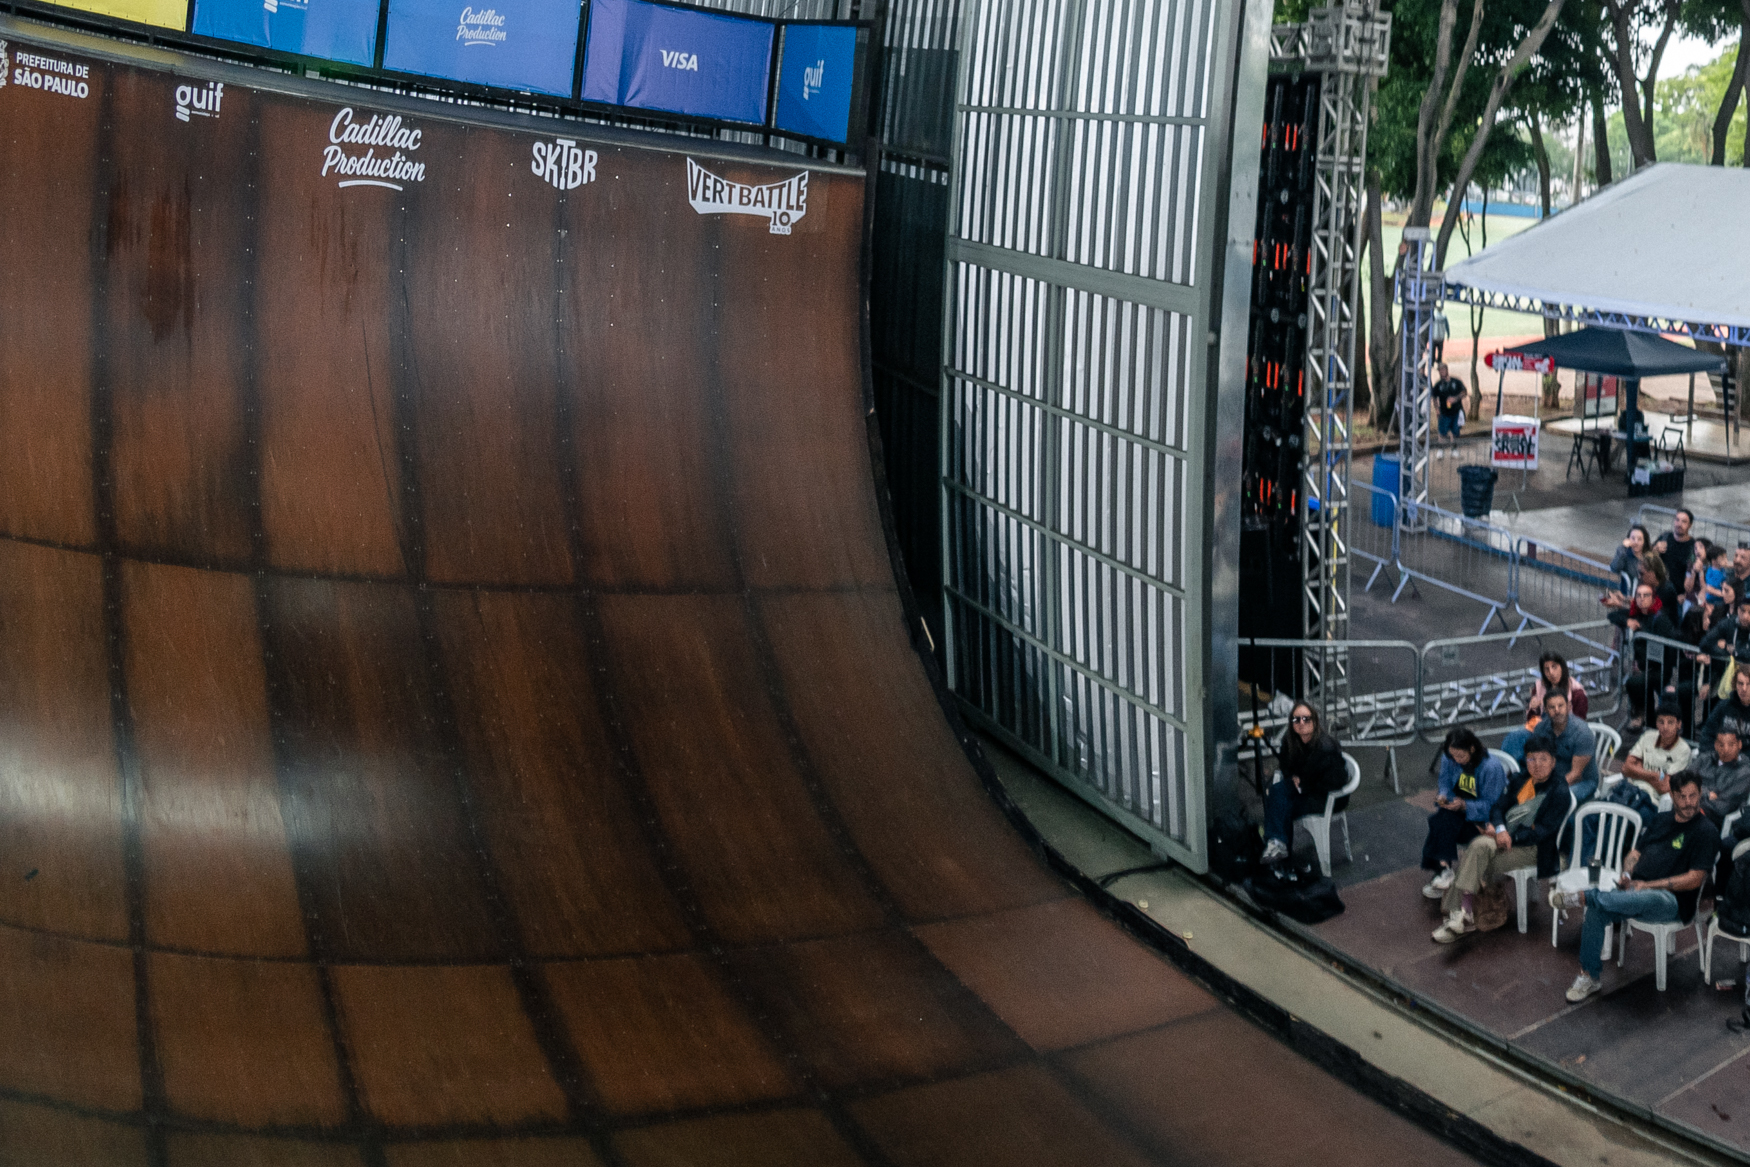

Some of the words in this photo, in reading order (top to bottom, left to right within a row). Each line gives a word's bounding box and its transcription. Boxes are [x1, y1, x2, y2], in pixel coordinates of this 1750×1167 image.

[460, 6, 506, 27] Cadillac
[455, 25, 507, 41] Production
[16, 51, 74, 76] PREFEITURA
[75, 64, 90, 79] DE
[659, 49, 699, 72] VISA
[14, 67, 43, 89] SÃO
[43, 74, 89, 99] PAULO
[329, 107, 422, 151] Cadillac
[321, 145, 426, 182] Production
[771, 210, 791, 227] 10
